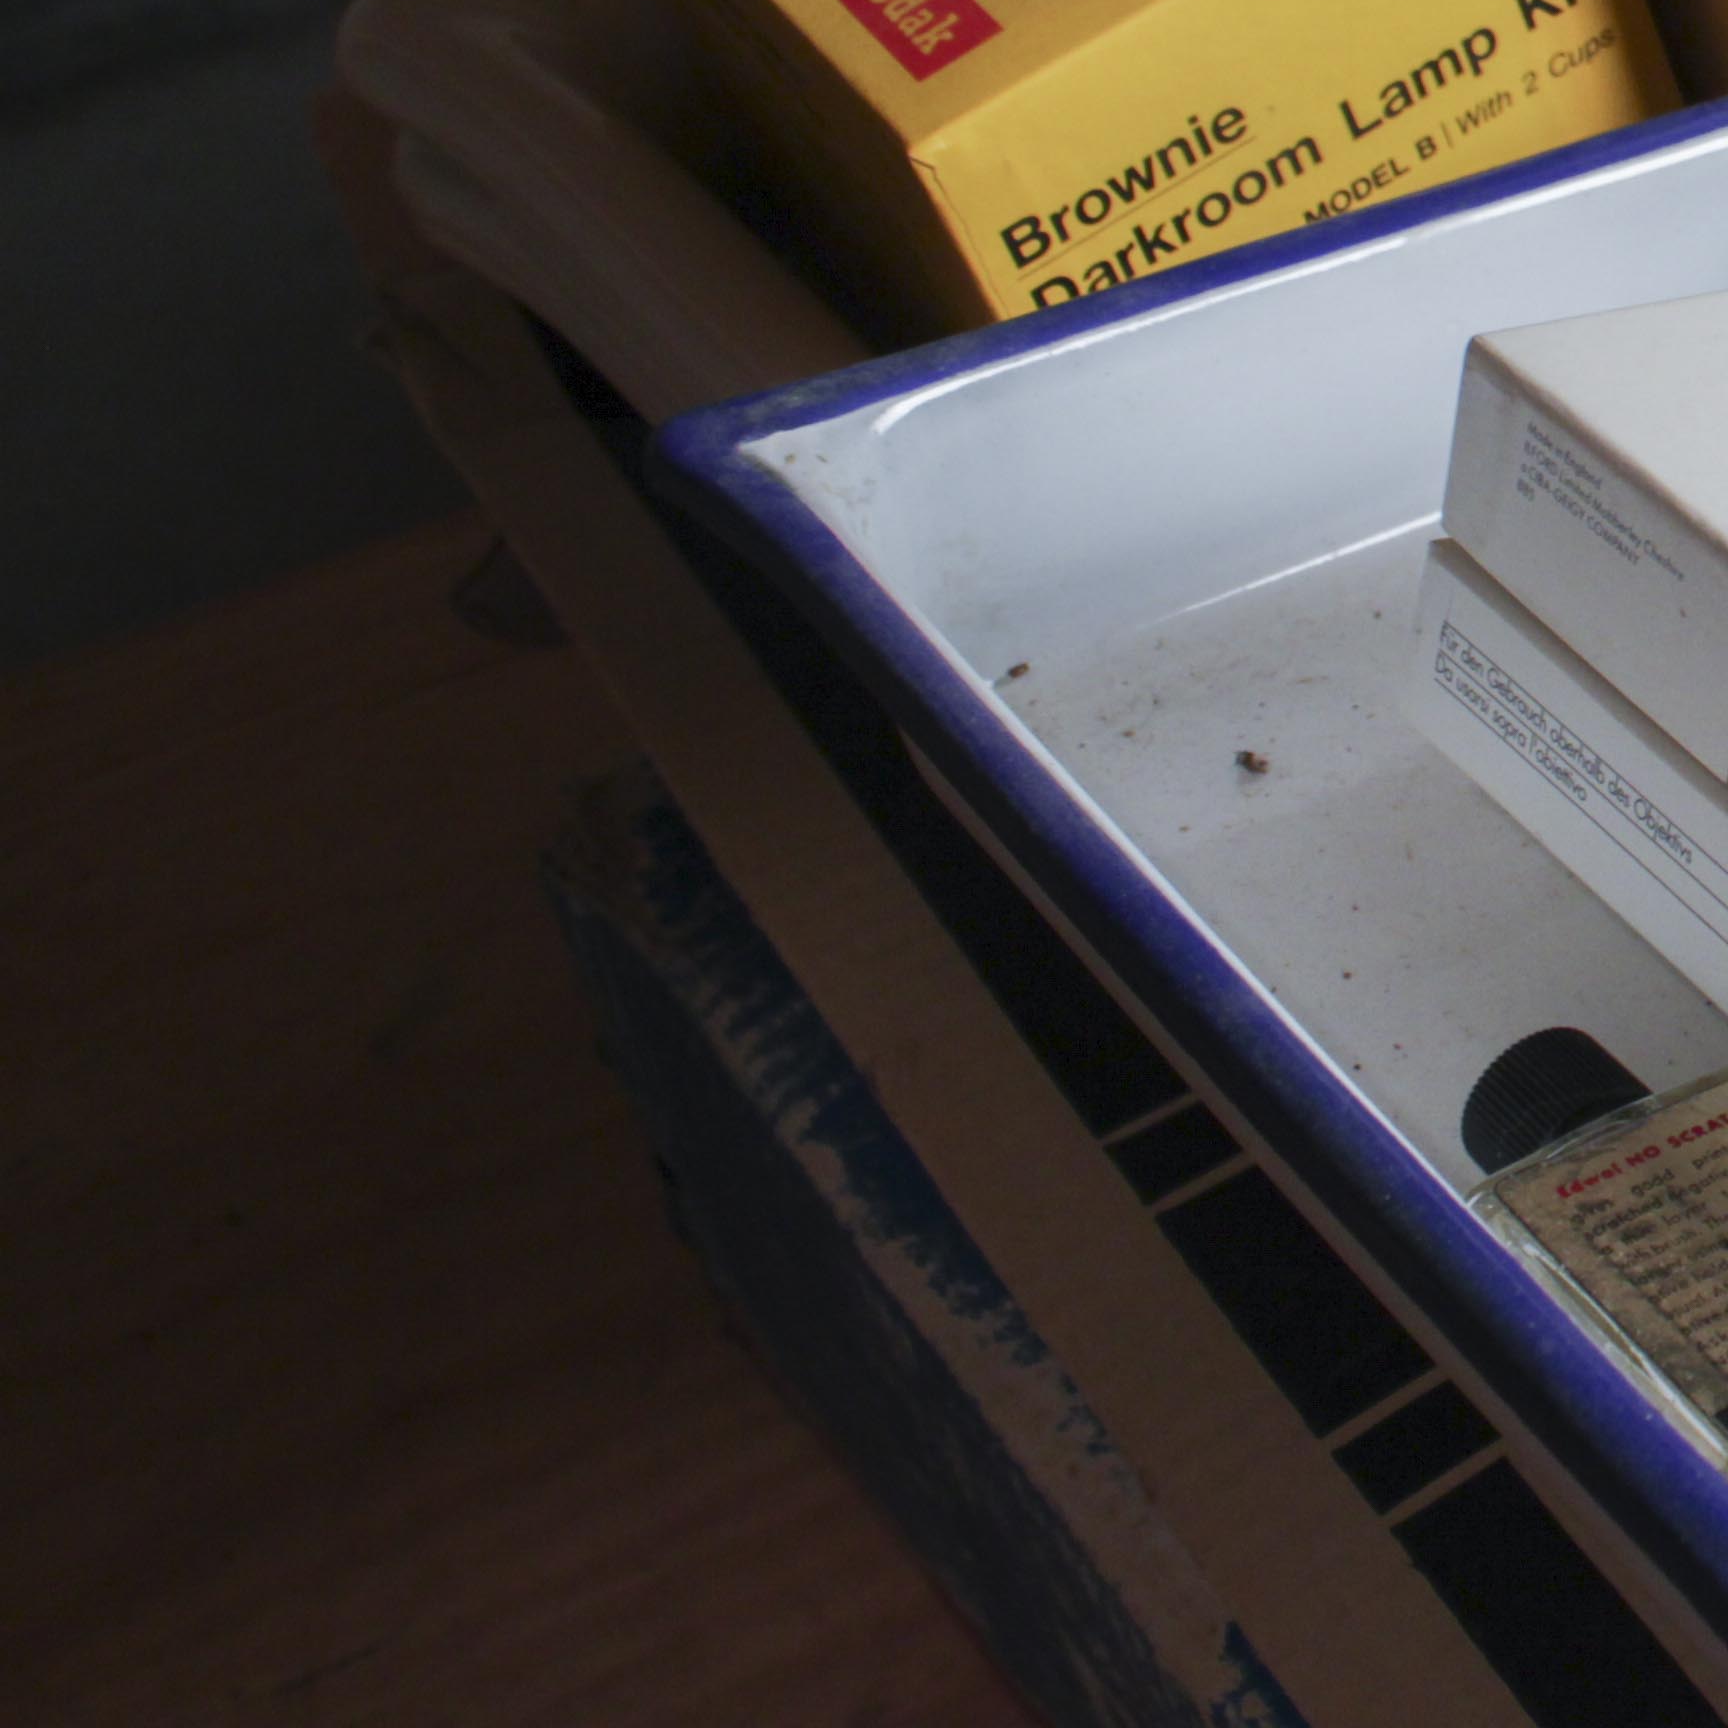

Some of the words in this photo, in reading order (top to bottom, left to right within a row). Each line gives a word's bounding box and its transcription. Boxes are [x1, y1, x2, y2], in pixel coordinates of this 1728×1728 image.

[1303, 159, 1410, 225] MODEL
[1415, 134, 1438, 163] B
[1453, 87, 1513, 137] With
[1521, 71, 1541, 95] 2
[1547, 28, 1617, 82] Cups
[1337, 26, 1497, 140] Lamp
[999, 105, 1248, 269] Brownie
[1486, 667, 1548, 733] Gebrauch
[1606, 772, 1632, 809] des
[1632, 796, 1694, 865] Objektivs
[1491, 709, 1527, 748] sopra
[1623, 1144, 1663, 1166] NO
